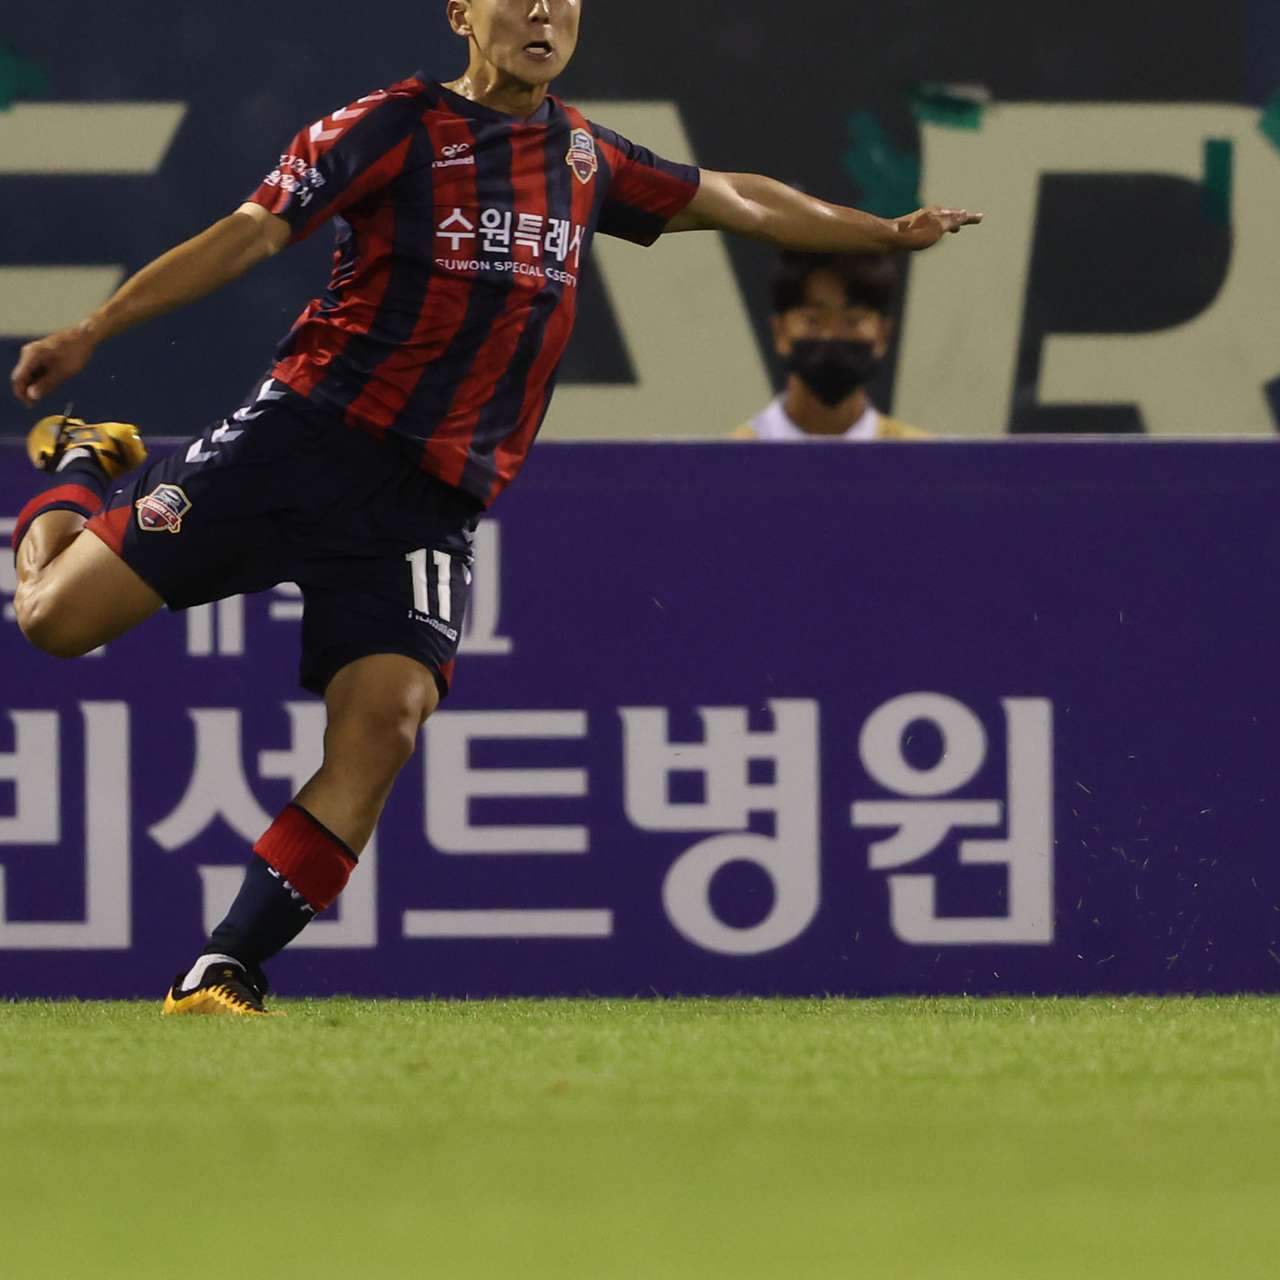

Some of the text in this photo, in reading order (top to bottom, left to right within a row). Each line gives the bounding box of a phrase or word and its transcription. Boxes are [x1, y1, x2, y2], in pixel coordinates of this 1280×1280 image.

[434, 258, 490, 271] SUWON
[493, 260, 545, 278] SPECIAL
[405, 547, 452, 622] 11
